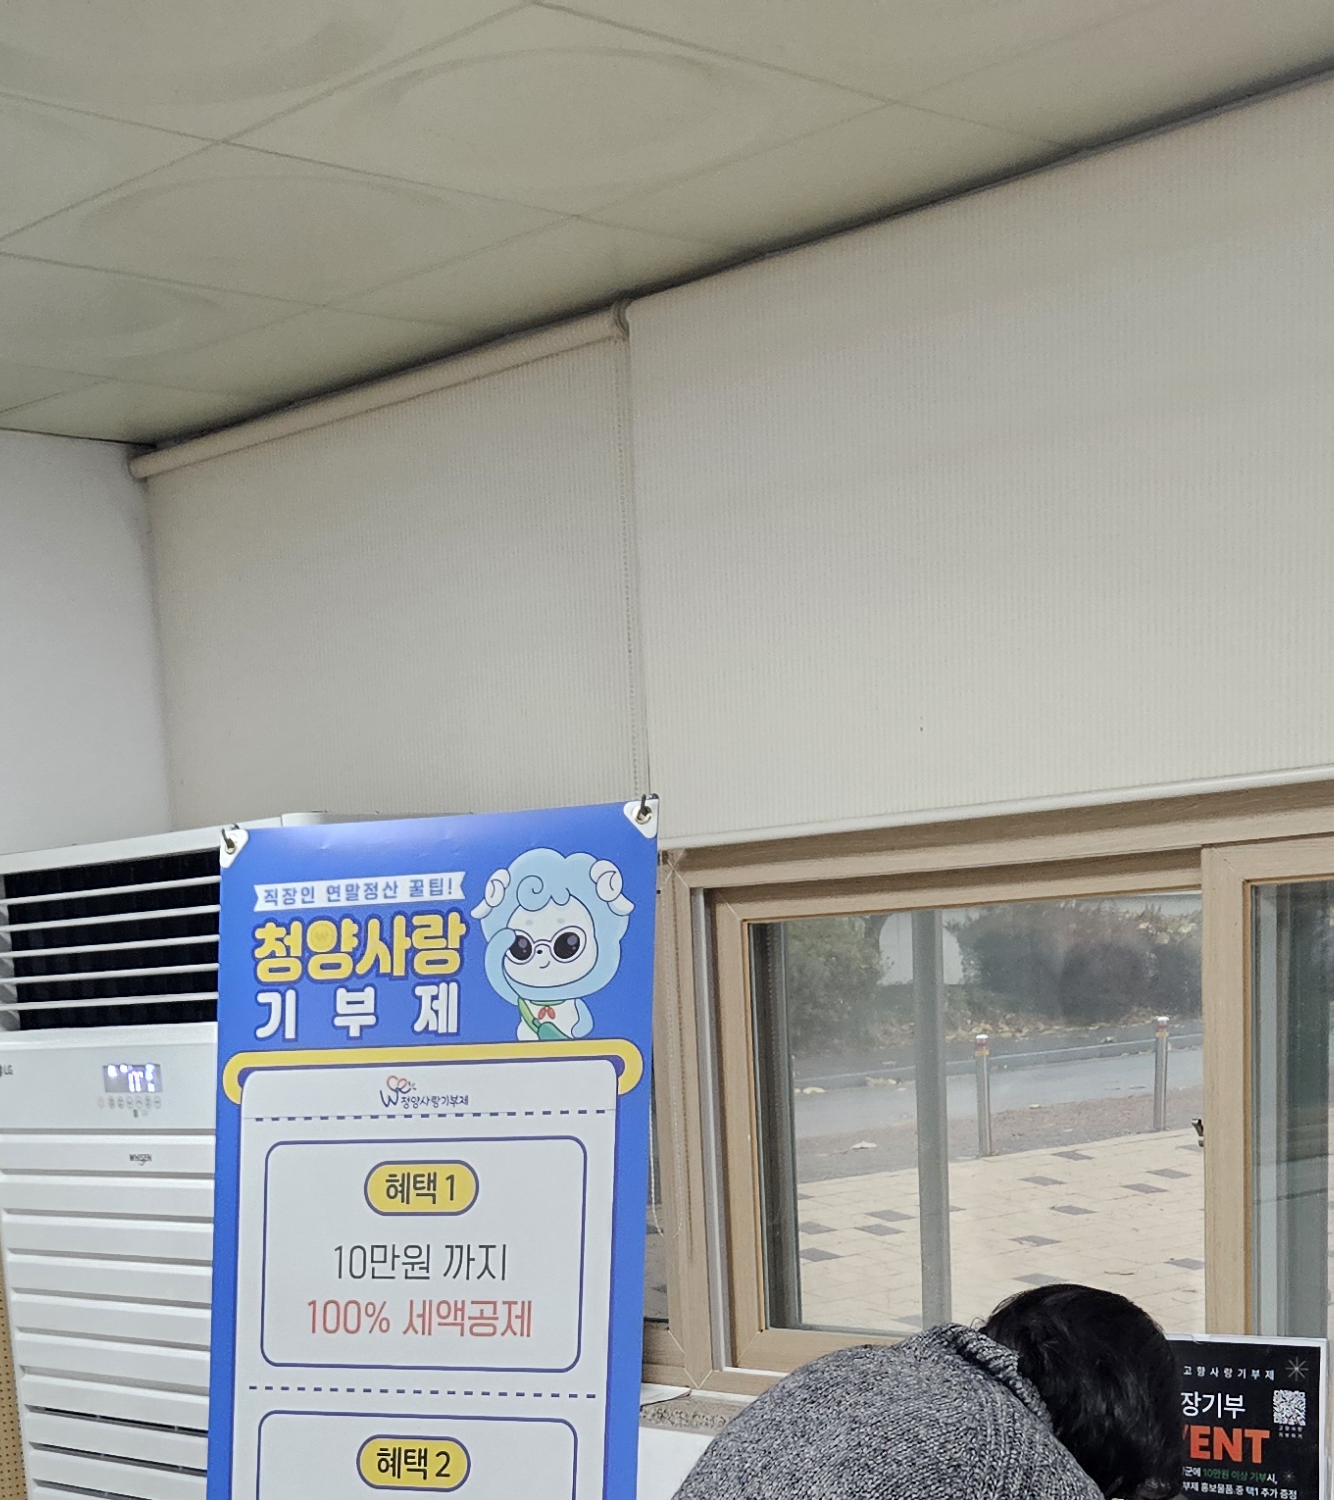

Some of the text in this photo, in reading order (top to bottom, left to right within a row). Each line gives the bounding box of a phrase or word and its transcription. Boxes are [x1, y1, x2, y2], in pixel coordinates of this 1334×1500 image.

[264, 877, 454, 907] 직장인 연말정산 꿀팁!
[254, 911, 467, 982] 청양사랑
[385, 1171, 456, 1205] 혜택 1
[334, 1243, 507, 1281] 10만원 까지
[307, 1299, 533, 1338] 100% 세액공제
[1183, 1365, 1275, 1381] 고향사랑기부제
[1180, 1391, 1246, 1420] 장기부
[1182, 1424, 1270, 1464] ENT
[377, 1446, 451, 1480] 혜택 2
[1182, 1466, 1201, 1477] 군에
[1203, 1468, 1229, 1479] 10만원
[1261, 1488, 1278, 1499] 추가
[1280, 1489, 1298, 1500] 증정
